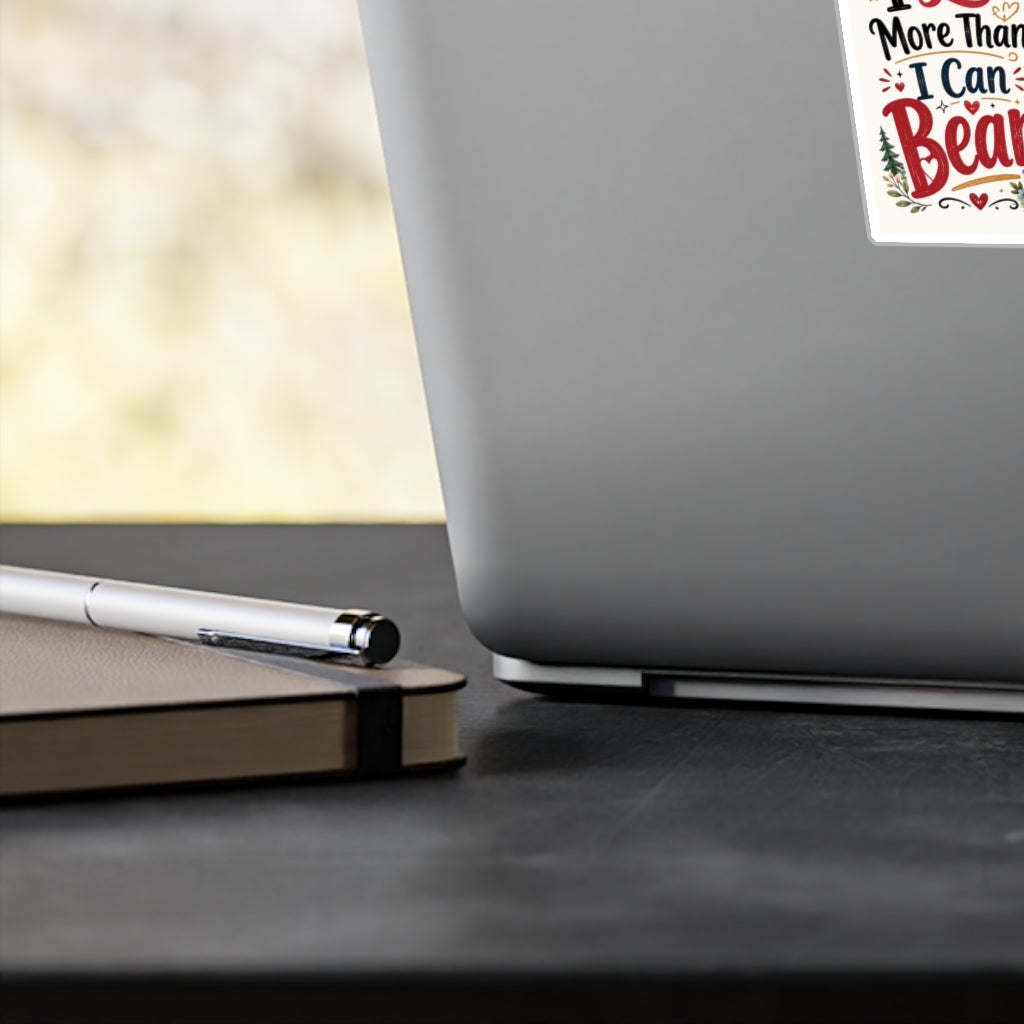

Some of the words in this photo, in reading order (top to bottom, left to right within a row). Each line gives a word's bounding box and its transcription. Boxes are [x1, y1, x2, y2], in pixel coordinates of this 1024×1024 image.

[869, 16, 954, 61] More
[909, 62, 934, 100] I
[941, 58, 1011, 98] Can
